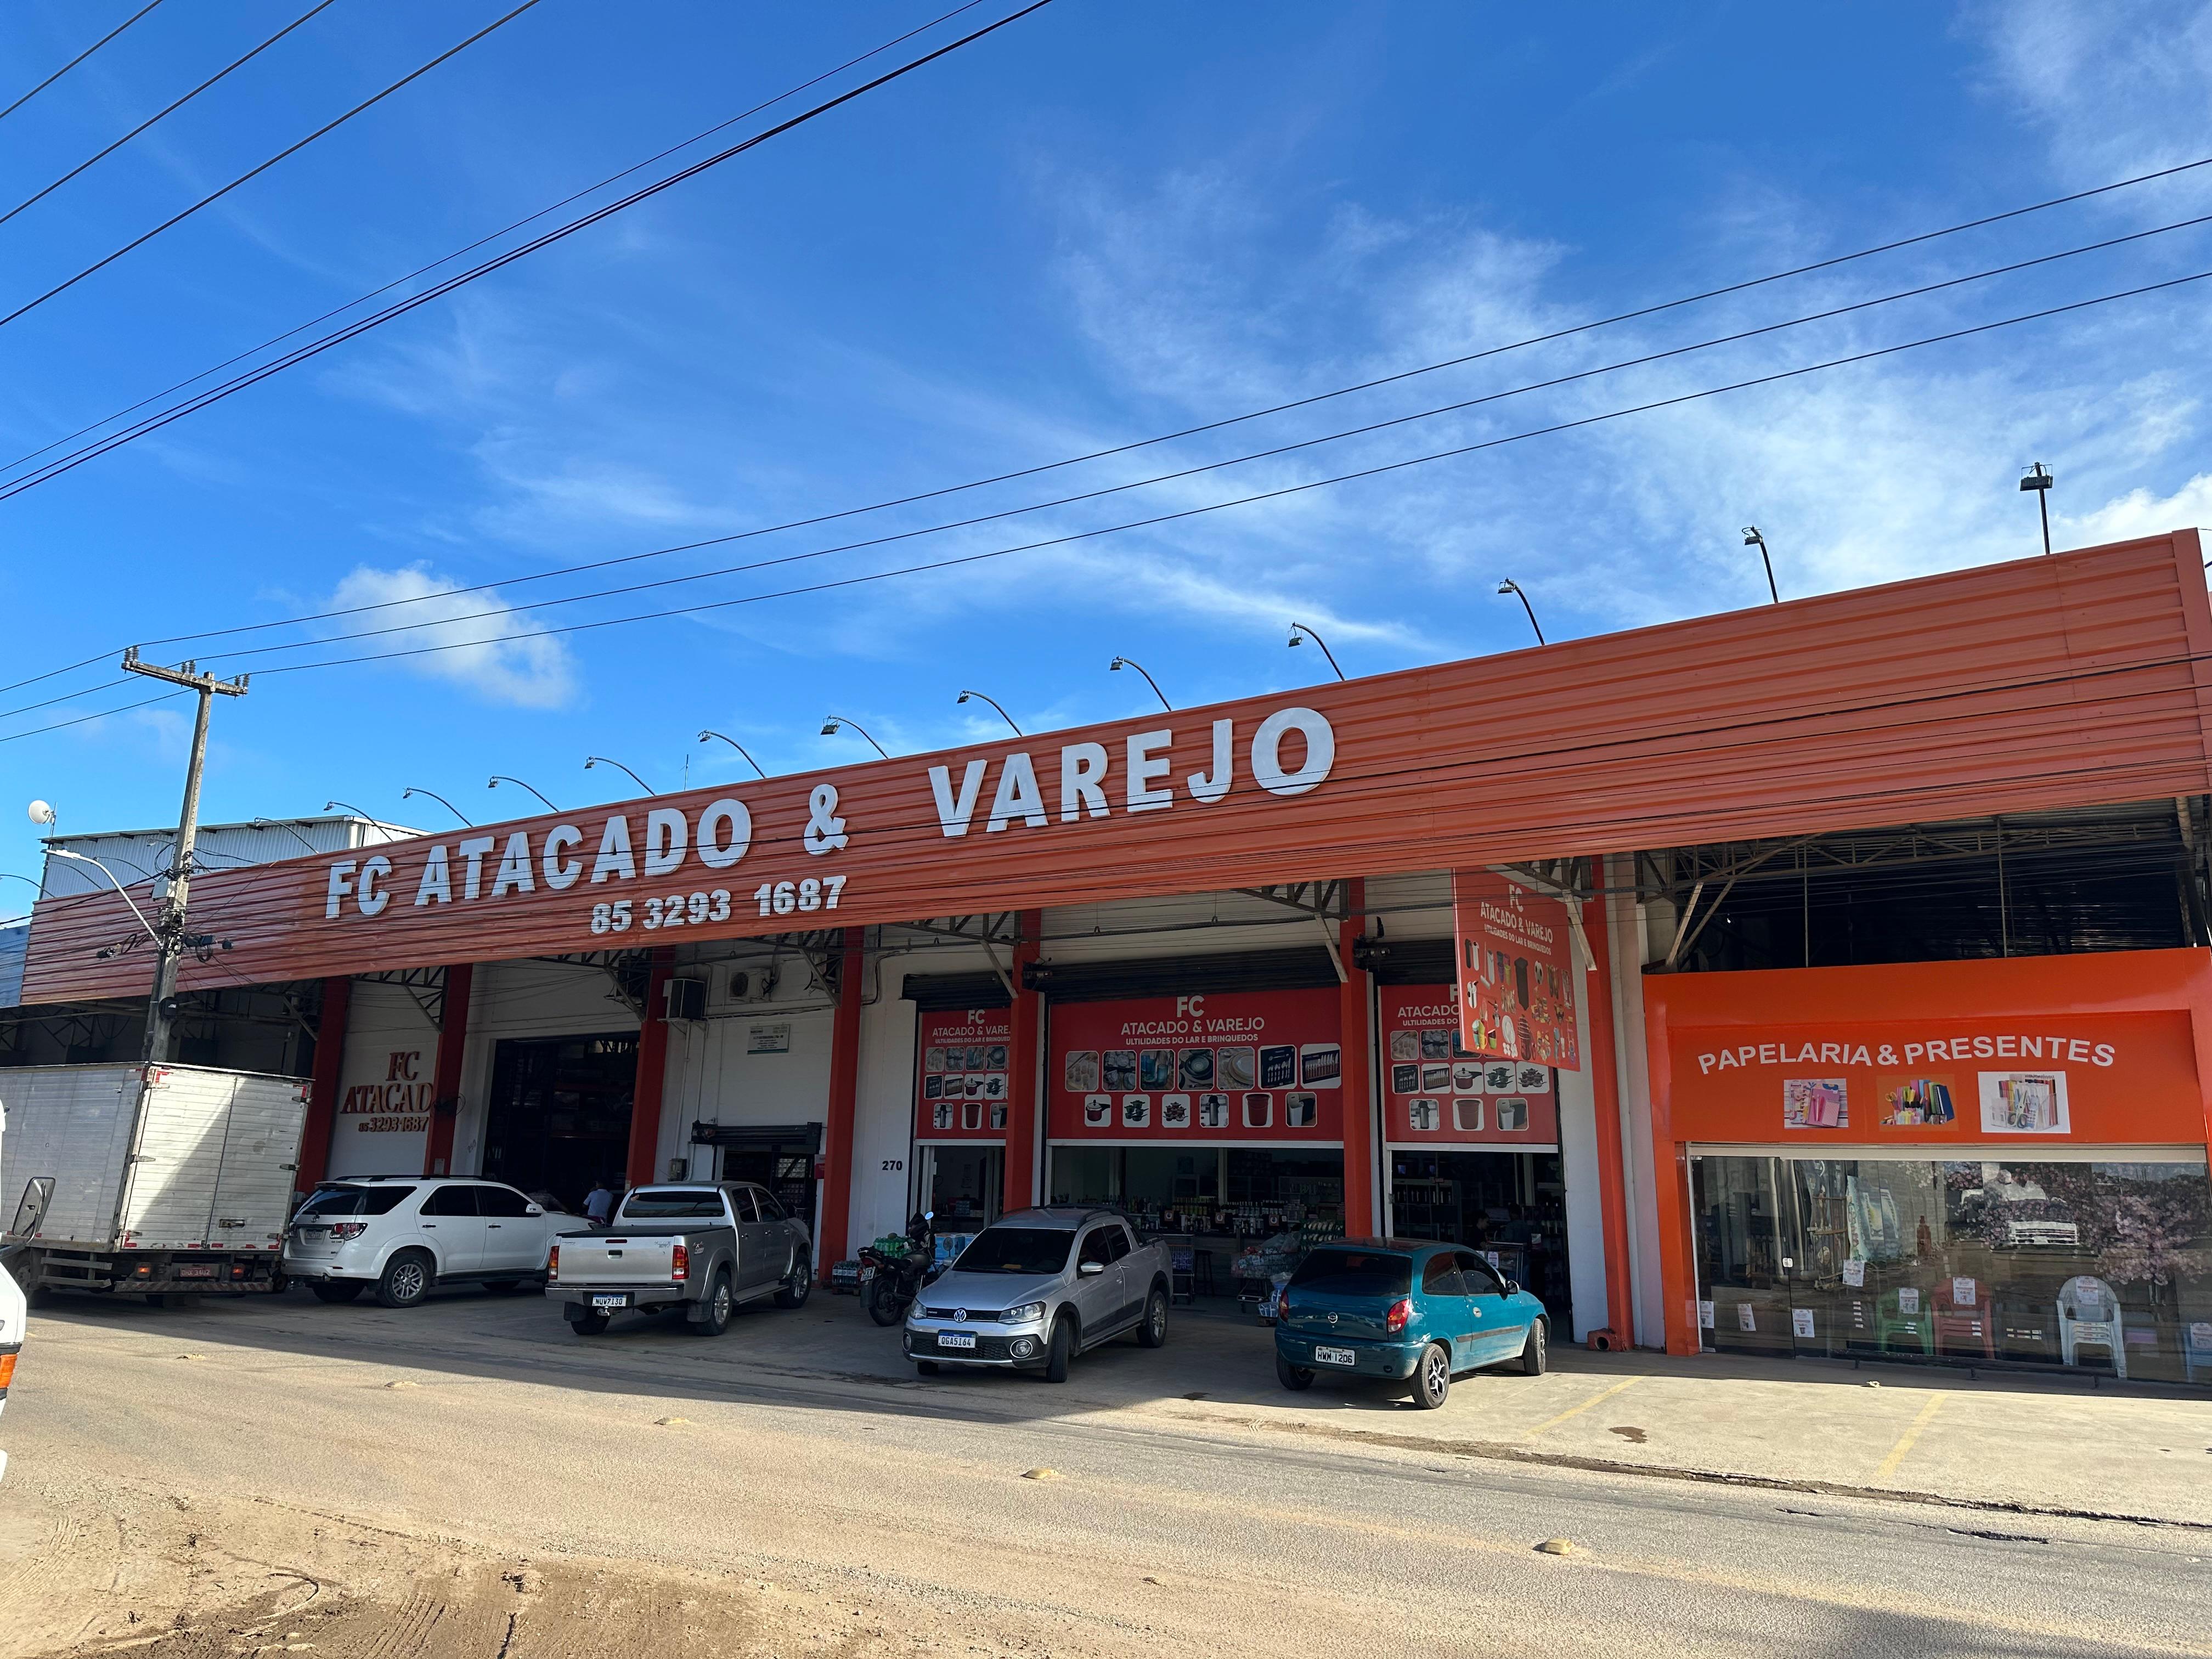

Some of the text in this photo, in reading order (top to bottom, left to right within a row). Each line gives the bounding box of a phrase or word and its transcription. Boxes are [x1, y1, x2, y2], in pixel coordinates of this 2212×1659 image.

[325, 707, 1335, 918] FC ATACADO & VAREJO
[590, 875, 847, 934] 85 3293 1687
[1509, 884, 1523, 912] FC
[1481, 901, 1553, 943] ATACADO & VAREJO
[1509, 933, 1515, 942] DO
[1515, 935, 1523, 945] LAR
[1523, 938, 1527, 947] E
[1527, 939, 1551, 956] BRINQUEDOS
[1449, 984, 1458, 1002] F
[968, 1009, 985, 1024] FC
[1177, 995, 1205, 1017] FC
[1397, 1005, 1459, 1018] ATACADO
[932, 1025, 1011, 1036] ATACADO & VARE
[1121, 1017, 1265, 1035] ATACADO & VAREJO
[1126, 1037, 1171, 1045] ULTILIDADES
[1207, 1034, 1259, 1042] BRINQUEDOS
[386, 1051, 420, 1081] FC
[1698, 1035, 2115, 1075] PAPELARIA & PRESENTES
[340, 1082, 433, 1114] ATACAD
[882, 1160, 902, 1171] 270
[1317, 1351, 1352, 1363] HWM 1206
